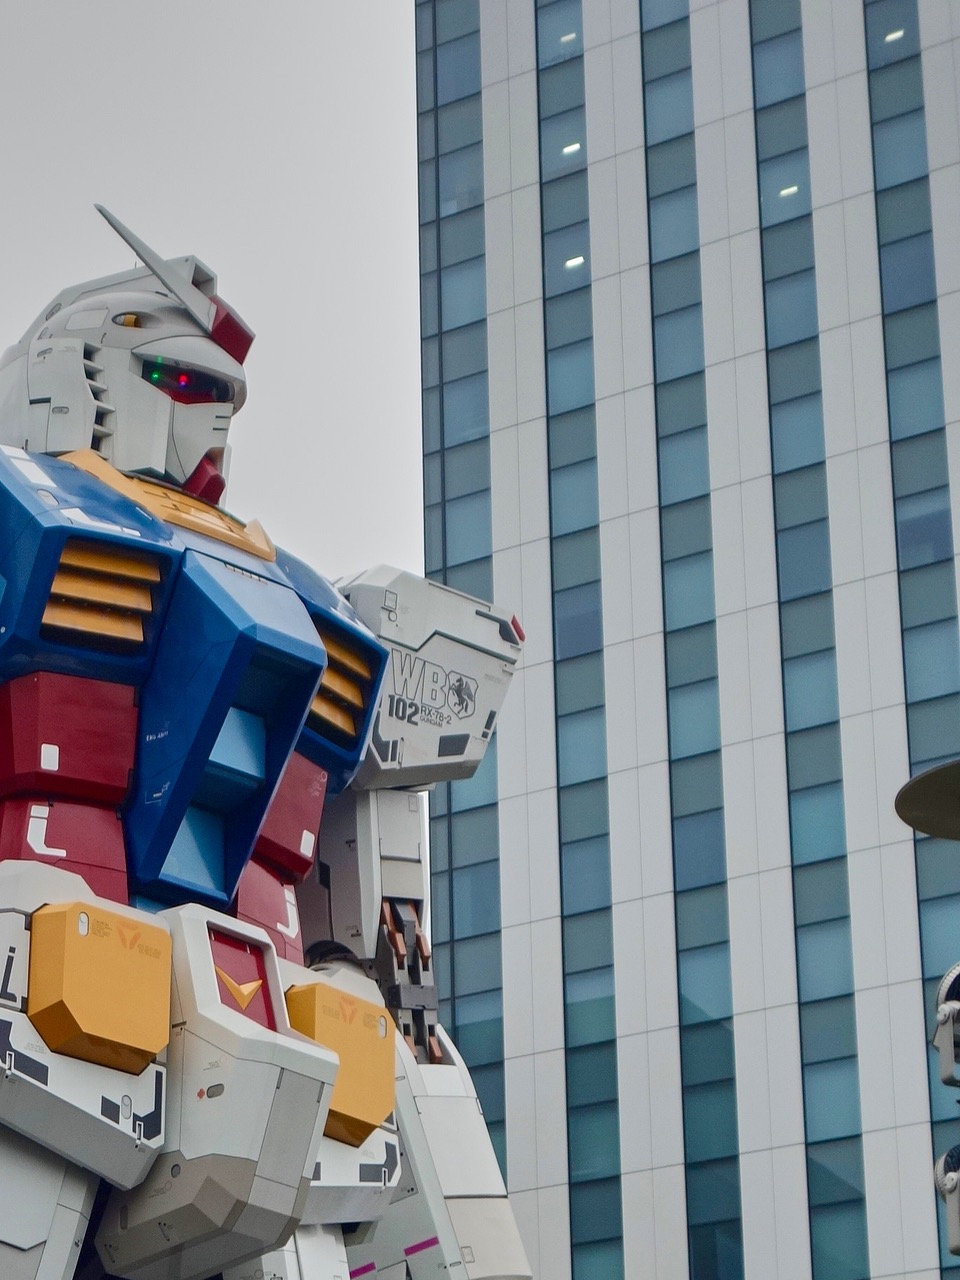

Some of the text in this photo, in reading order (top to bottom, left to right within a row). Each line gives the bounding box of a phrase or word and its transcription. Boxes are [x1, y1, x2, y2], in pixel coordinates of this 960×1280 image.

[392, 648, 448, 710] WB
[388, 694, 419, 727] 102
[420, 705, 452, 725] RX-78-2
